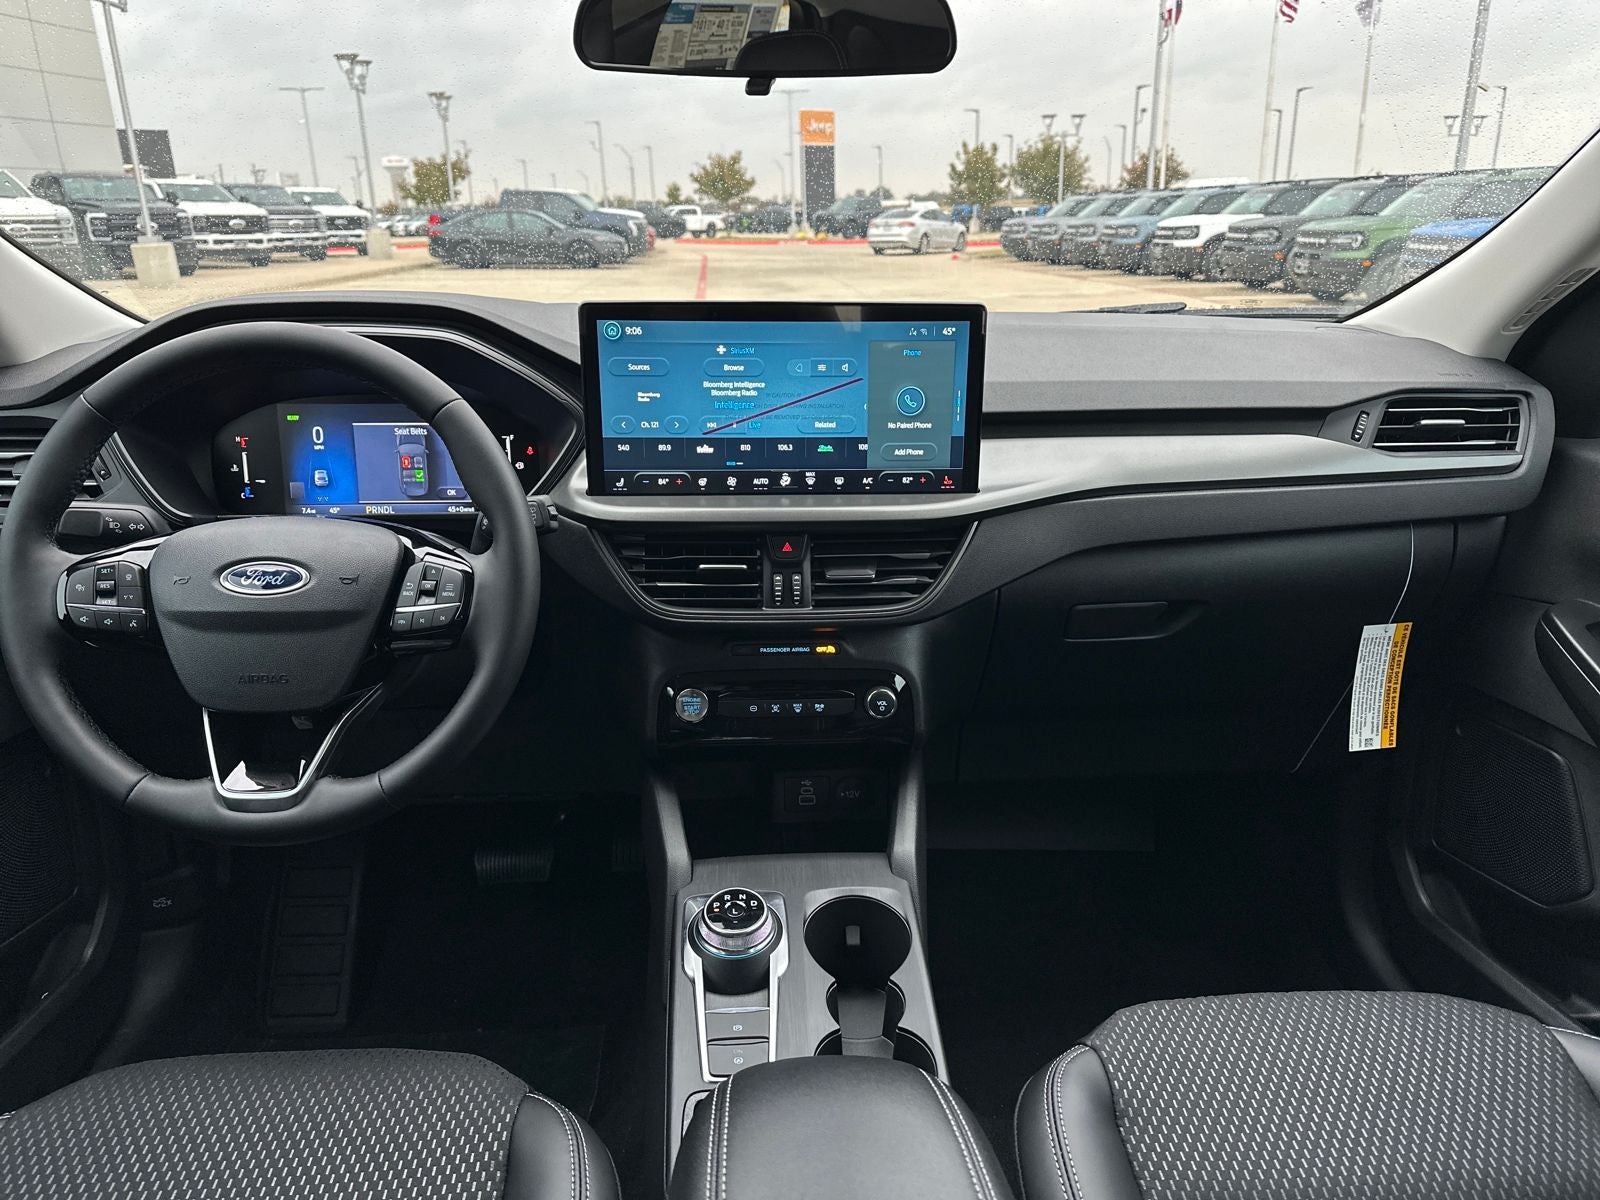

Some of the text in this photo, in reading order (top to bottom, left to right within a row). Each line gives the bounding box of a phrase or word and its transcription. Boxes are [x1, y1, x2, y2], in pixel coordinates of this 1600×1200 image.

[624, 327, 643, 335] 9:06
[729, 346, 755, 355] SiriusXM
[903, 348, 922, 356] Phone
[627, 363, 651, 371] Sources
[723, 363, 745, 371] Browse
[703, 380, 766, 389] Bloomberg Intelligence
[710, 389, 741, 397] Bloomberg
[714, 400, 755, 410] Intelligence
[748, 421, 761, 430] Live
[312, 426, 324, 444] 0
[894, 448, 924, 456] Add Phone
[366, 506, 395, 514] PRNDL
[240, 569, 287, 586] Ford
[238, 673, 289, 684] AIRBAG
